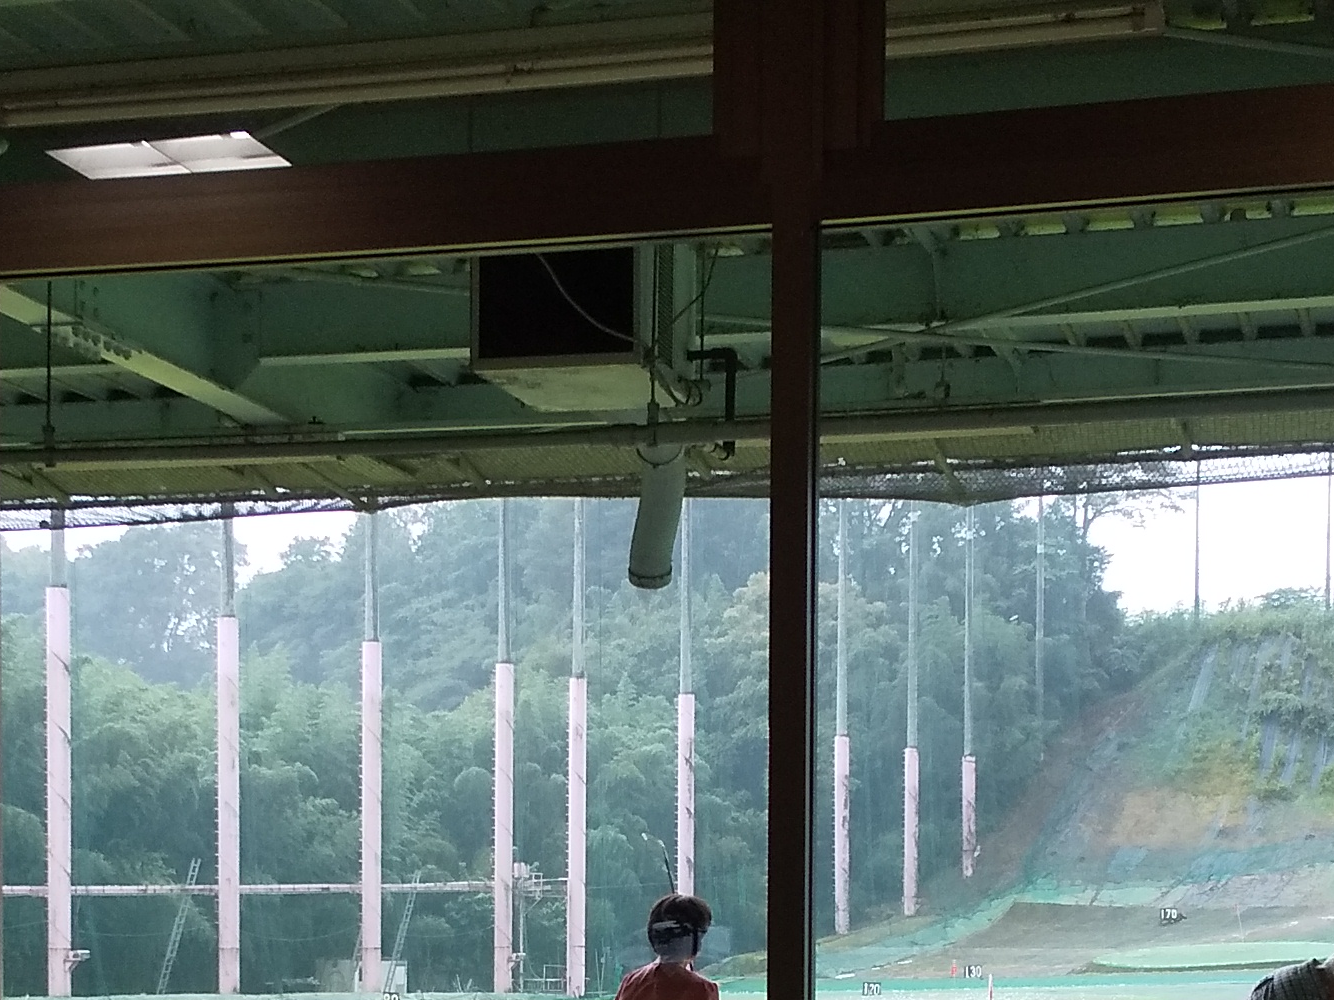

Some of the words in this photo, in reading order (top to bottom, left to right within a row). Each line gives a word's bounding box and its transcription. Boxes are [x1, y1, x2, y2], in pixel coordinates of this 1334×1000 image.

[1161, 908, 1178, 919] 170
[966, 965, 982, 978] 130
[863, 982, 880, 995] 120
